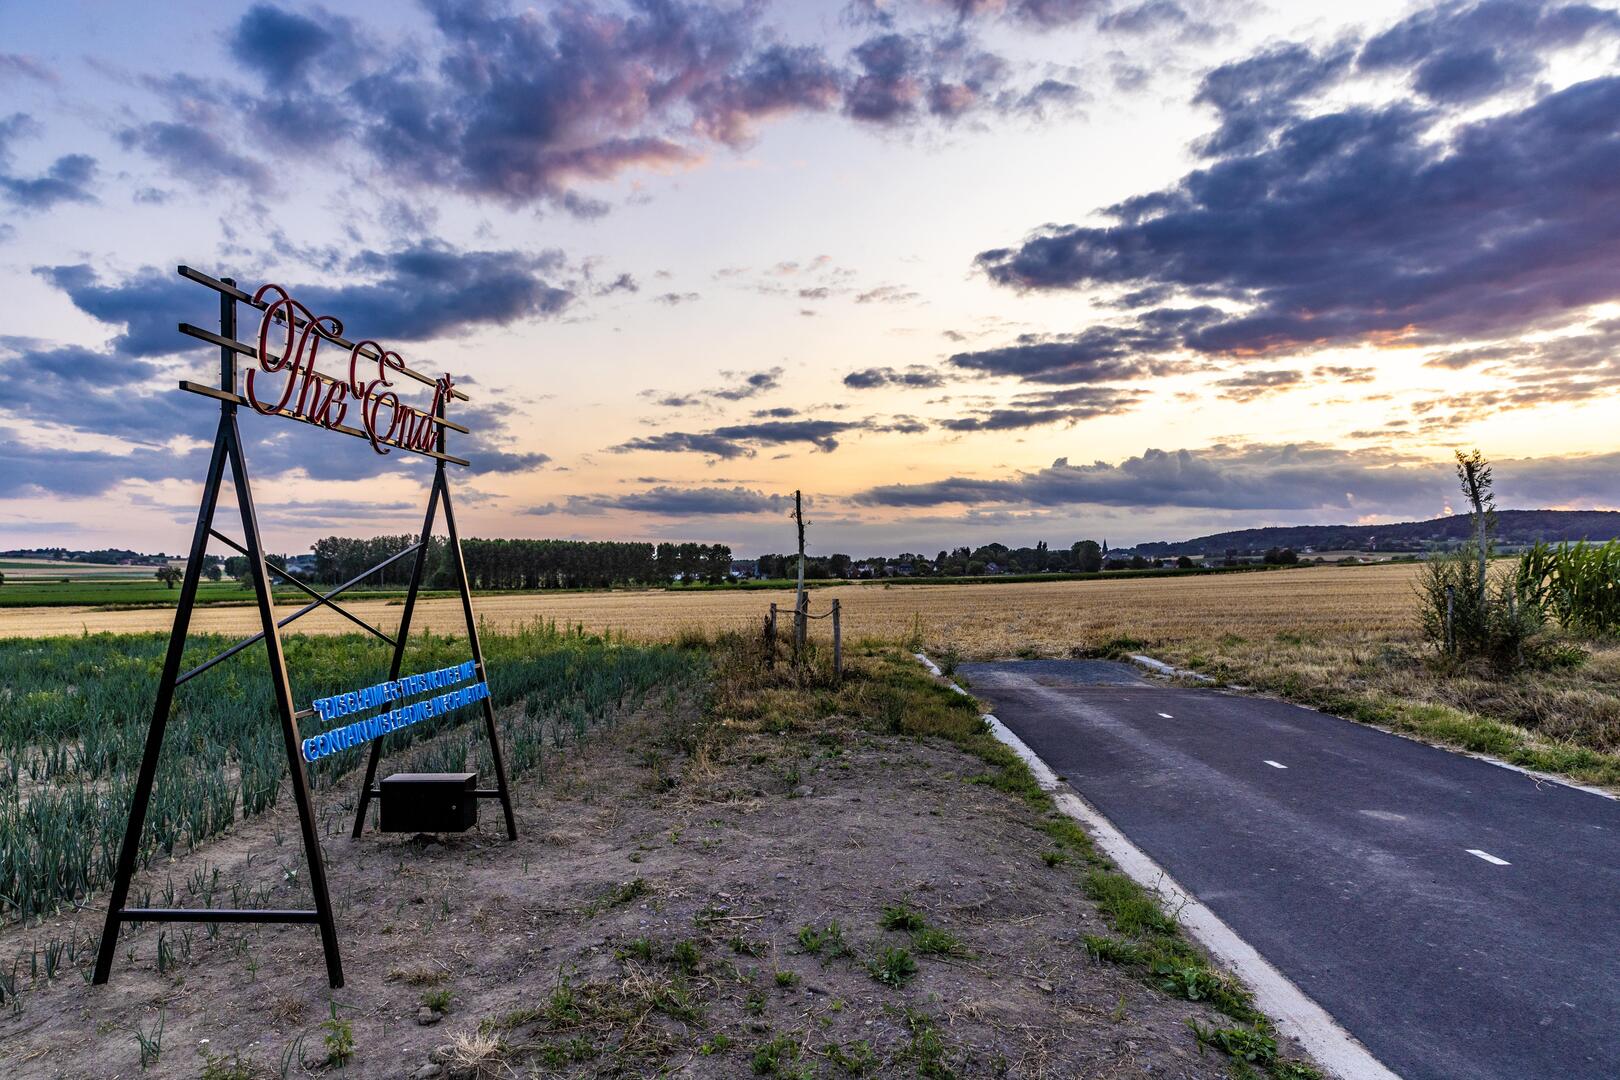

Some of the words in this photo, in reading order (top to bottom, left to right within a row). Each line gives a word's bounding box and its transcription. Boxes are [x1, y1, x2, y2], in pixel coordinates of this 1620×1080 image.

[244, 283, 348, 430] The
[397, 674, 428, 697] THIS
[425, 665, 461, 692] NOTICE
[459, 659, 476, 680] MAY
[301, 719, 370, 762] CONTAIN
[367, 700, 434, 738] MISLEADING
